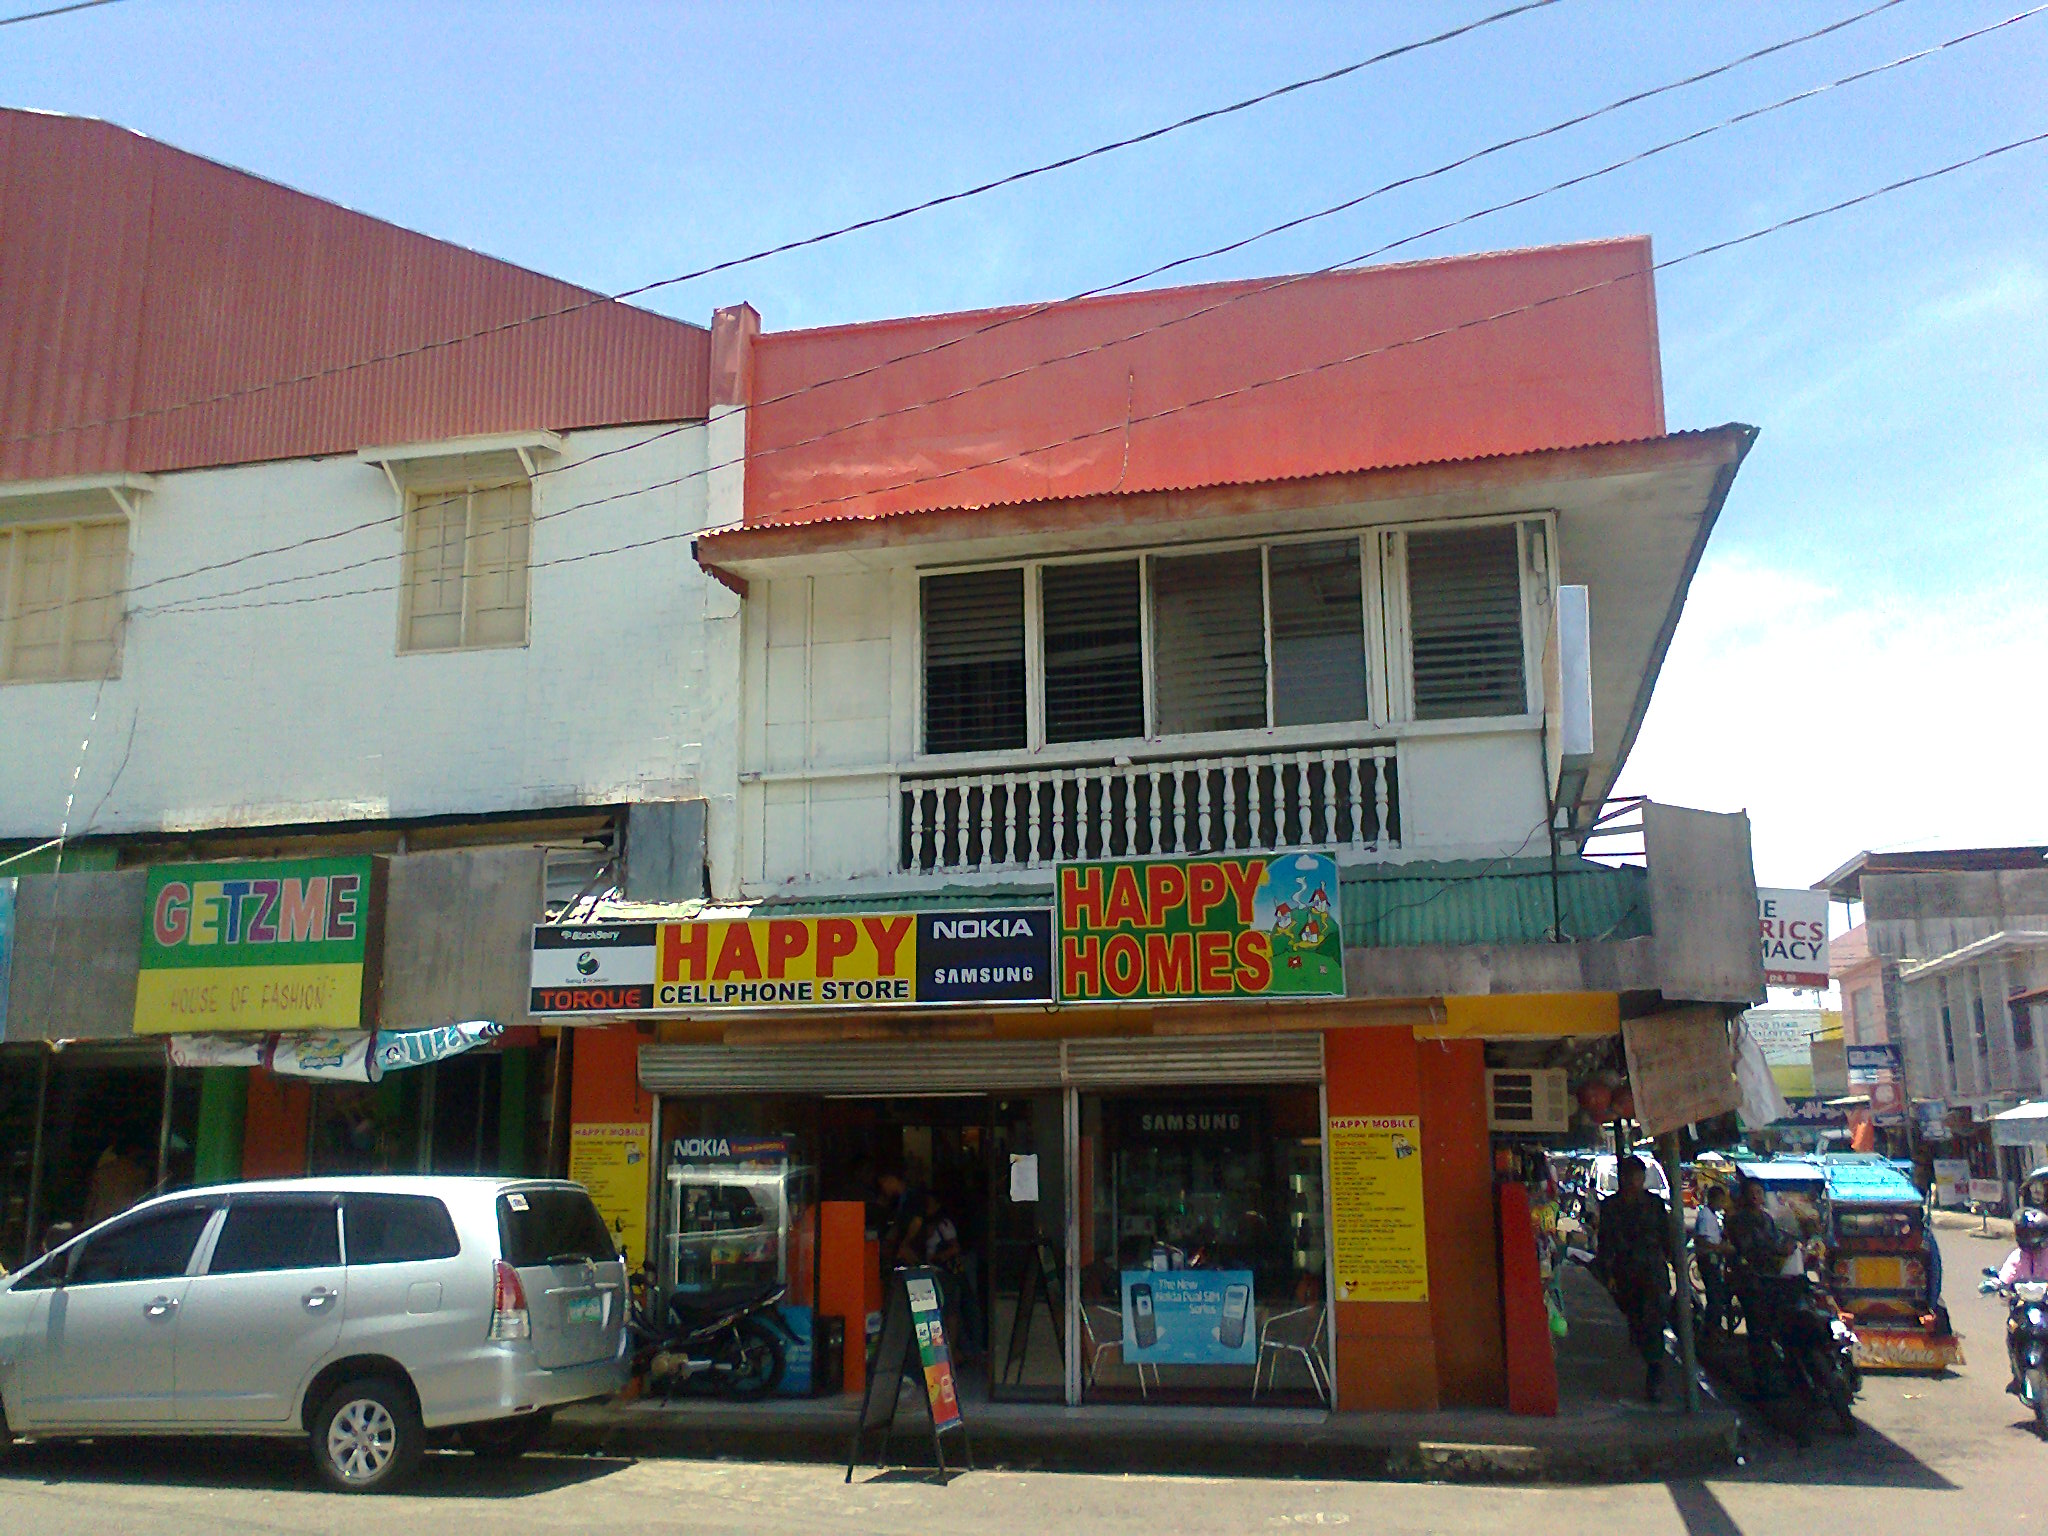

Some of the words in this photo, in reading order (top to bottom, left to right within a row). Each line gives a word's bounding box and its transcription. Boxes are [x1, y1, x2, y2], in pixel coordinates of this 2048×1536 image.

[1062, 860, 1266, 930] HAPPY
[154, 874, 361, 947] GETZME
[932, 918, 1034, 940] NOKIA
[662, 917, 914, 982] HAPPY
[1062, 930, 1272, 997] HOMES
[934, 966, 1034, 985] SAMSUNG
[171, 985, 218, 1014] HOUSE
[231, 985, 250, 1013] OF
[261, 979, 325, 1010] FASHION
[539, 988, 642, 1010] TORQUE
[659, 981, 812, 1004] CELLPHONE
[821, 979, 908, 1000] STORE
[1142, 1113, 1240, 1131] SAMSUNG
[1330, 1120, 1369, 1129] HAPPY
[674, 1138, 731, 1157] NOKIA
